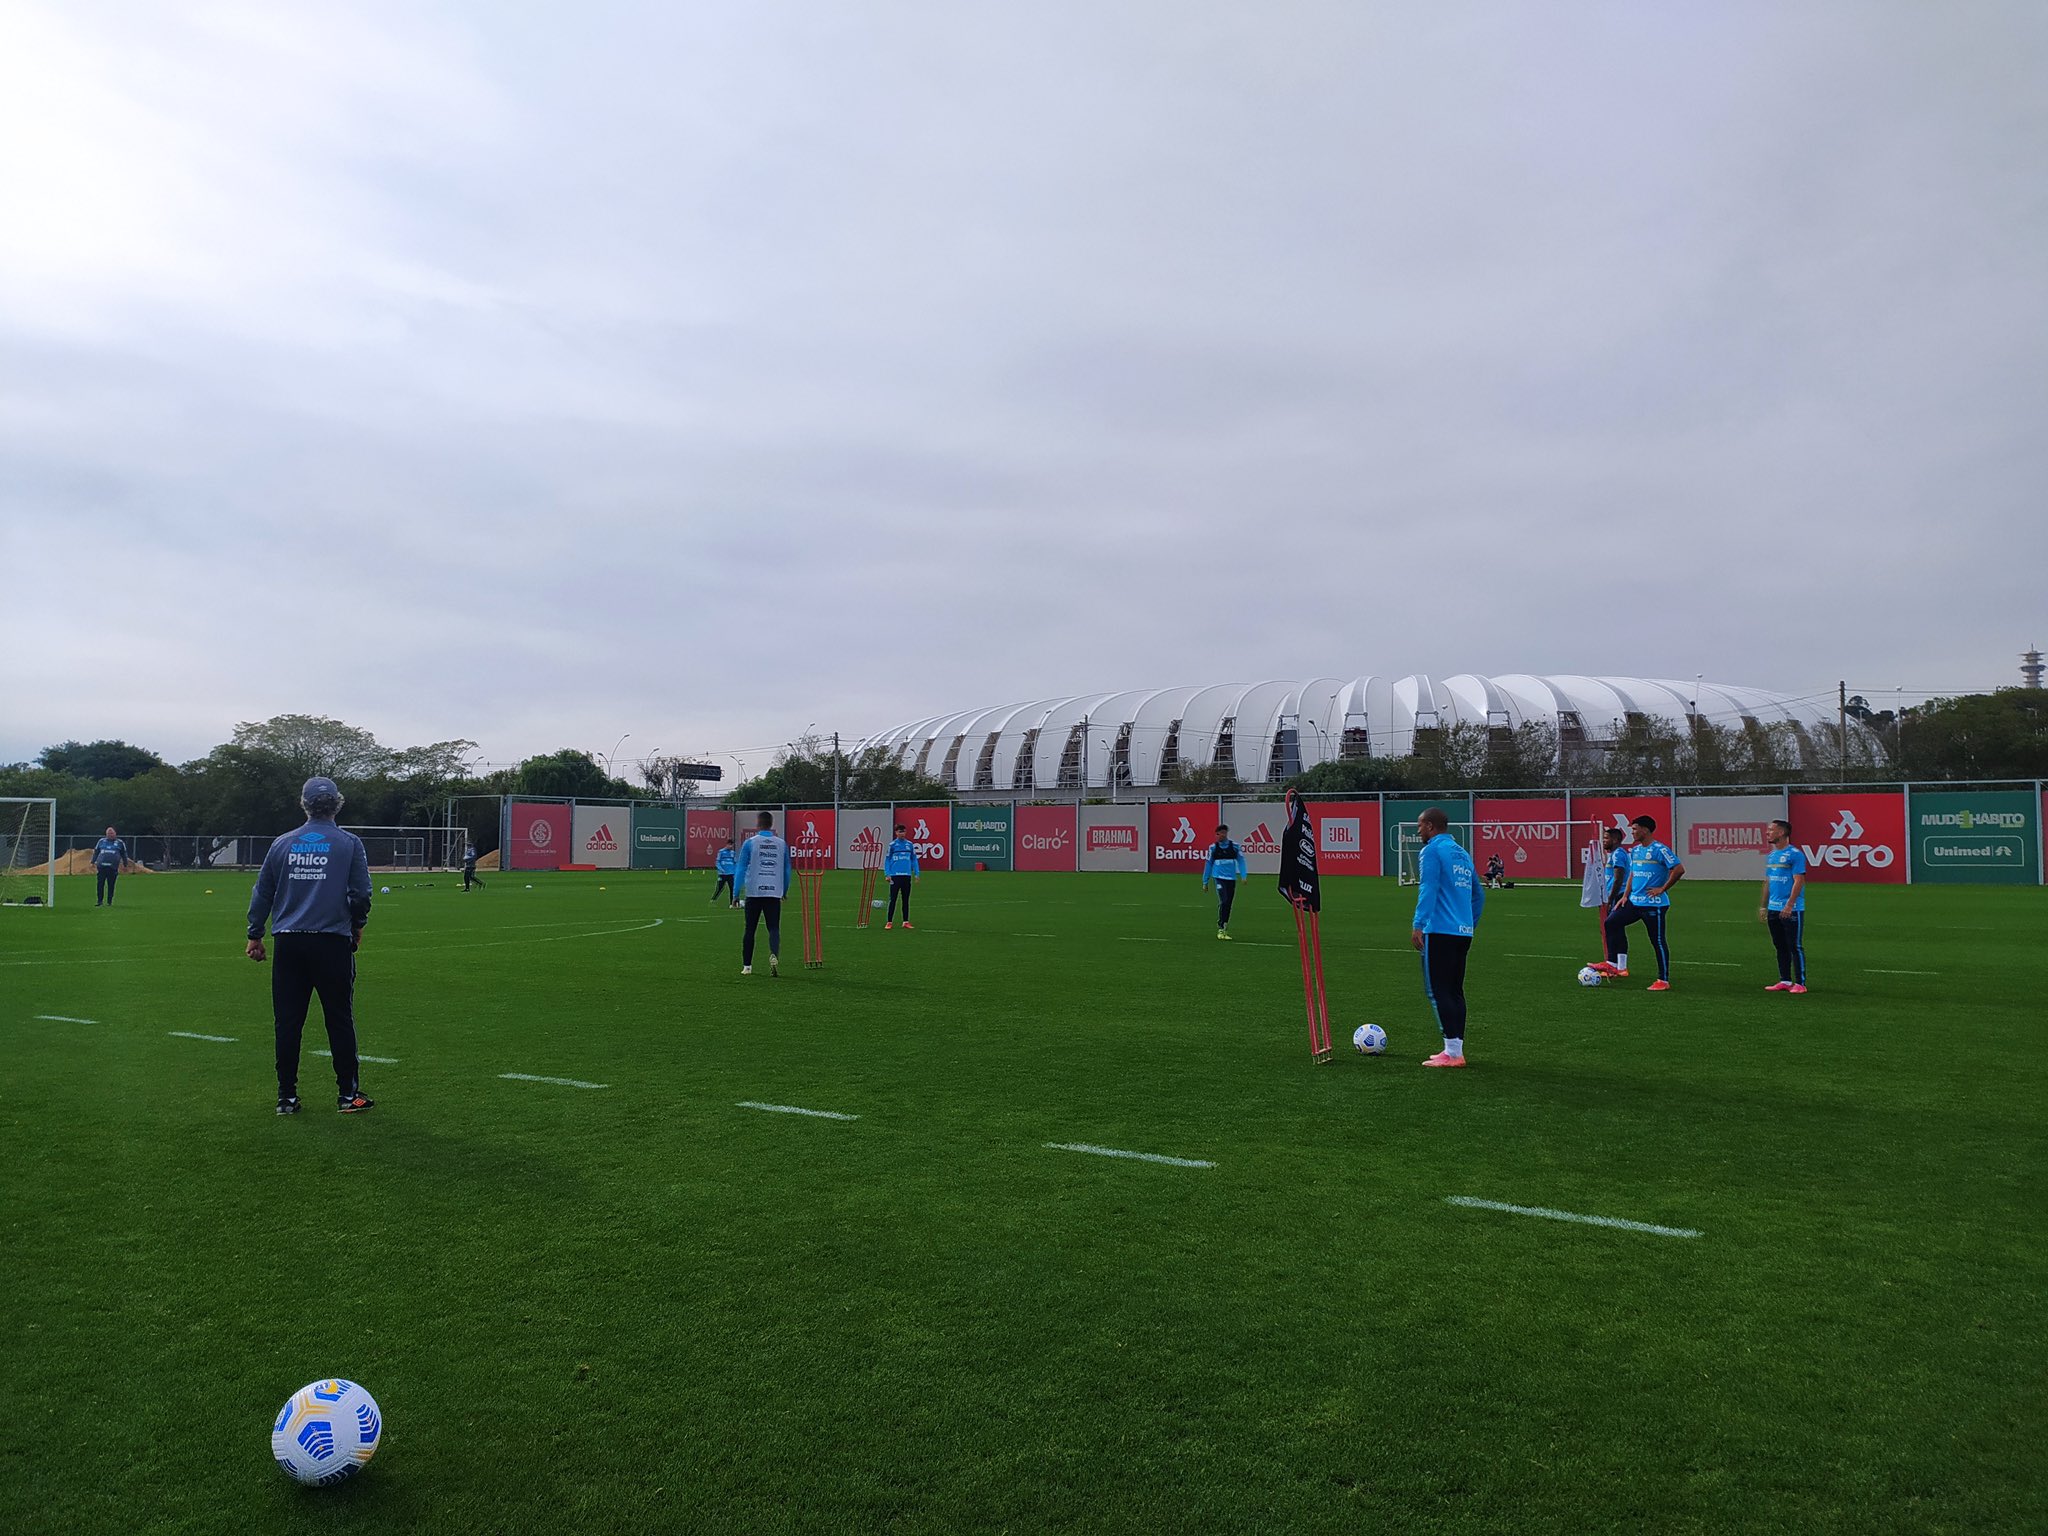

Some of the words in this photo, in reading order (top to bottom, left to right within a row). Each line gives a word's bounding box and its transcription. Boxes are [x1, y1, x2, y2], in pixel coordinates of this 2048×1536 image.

[640, 834, 667, 842] Unimed
[690, 825, 730, 839] SARANDI
[1092, 829, 1133, 844] BRAHMA
[1329, 827, 1353, 842] JBL
[1482, 824, 1559, 840] SARANDI
[1698, 827, 1763, 845] BRAHMA
[291, 843, 330, 853] SANTOS
[586, 840, 618, 851] adidas
[1022, 834, 1061, 849] Claro
[1240, 842, 1281, 854] adidas
[913, 842, 945, 859] ero
[1801, 845, 1894, 868] vero
[1933, 846, 1990, 856] Unimed
[288, 853, 329, 866] Philco
